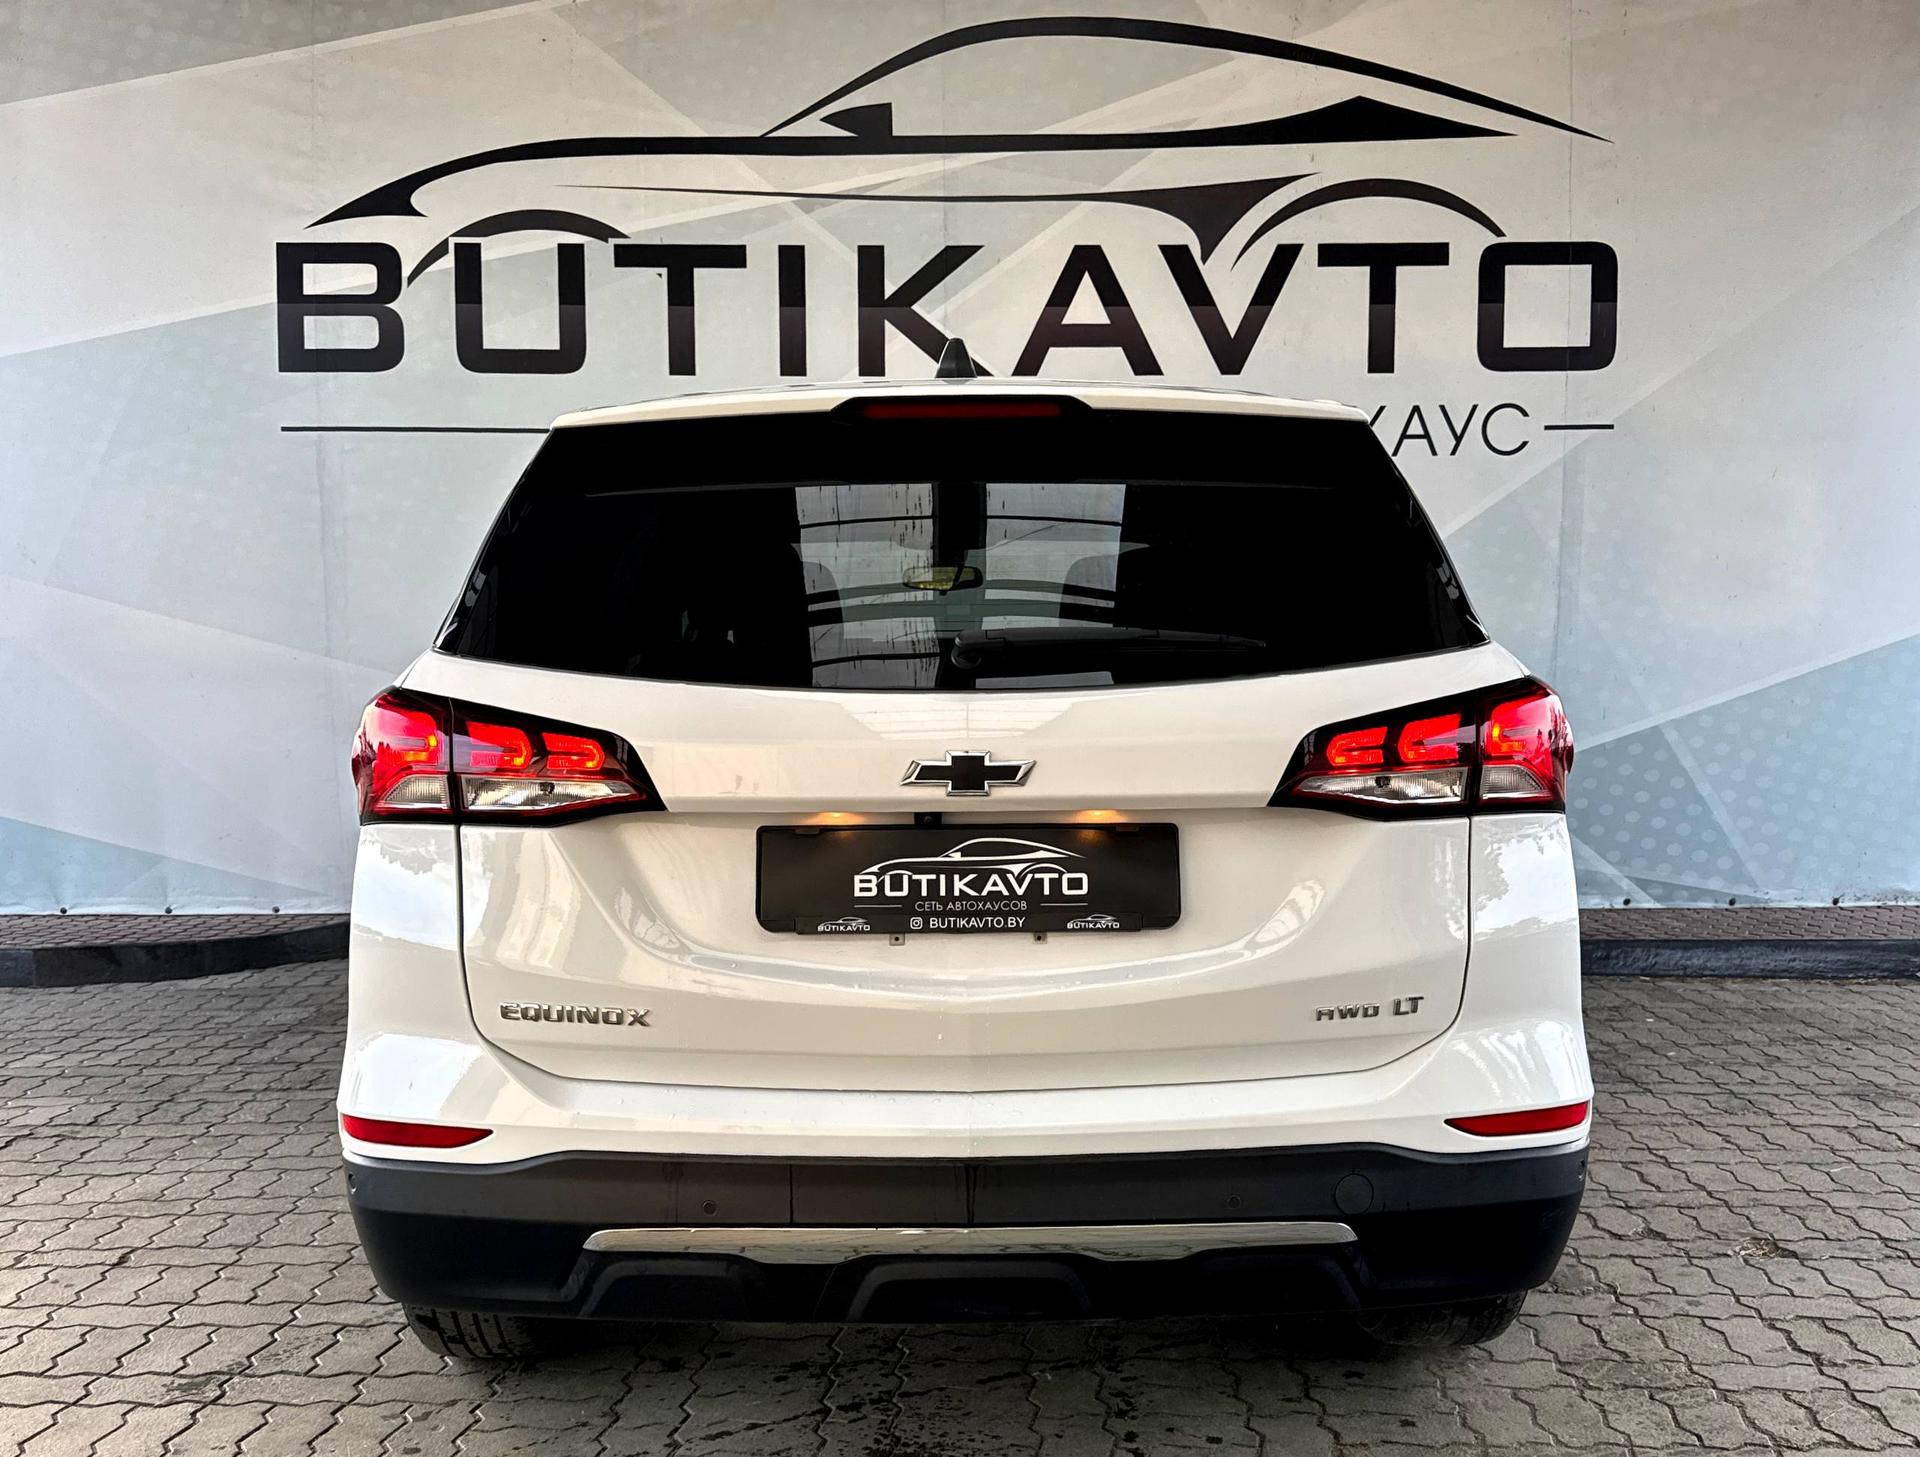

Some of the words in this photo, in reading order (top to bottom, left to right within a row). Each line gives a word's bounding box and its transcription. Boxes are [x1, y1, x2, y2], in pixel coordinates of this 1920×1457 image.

[276, 240, 1618, 376] BUTIKAVTO
[1368, 403, 1530, 457] АУС
[853, 872, 1089, 897] BUTIKAVTO
[914, 900, 943, 912] СЕТЬ
[946, 900, 1028, 912] АВТОХАУСОВ
[817, 923, 871, 932] BUTIKAVTO
[929, 916, 1026, 929] BUTIKAVTO.BY
[1066, 921, 1120, 929] BUTIKAVTO
[500, 1003, 650, 1027] EQUINOX
[1316, 1003, 1380, 1021] AWD
[1393, 996, 1424, 1016] LT
